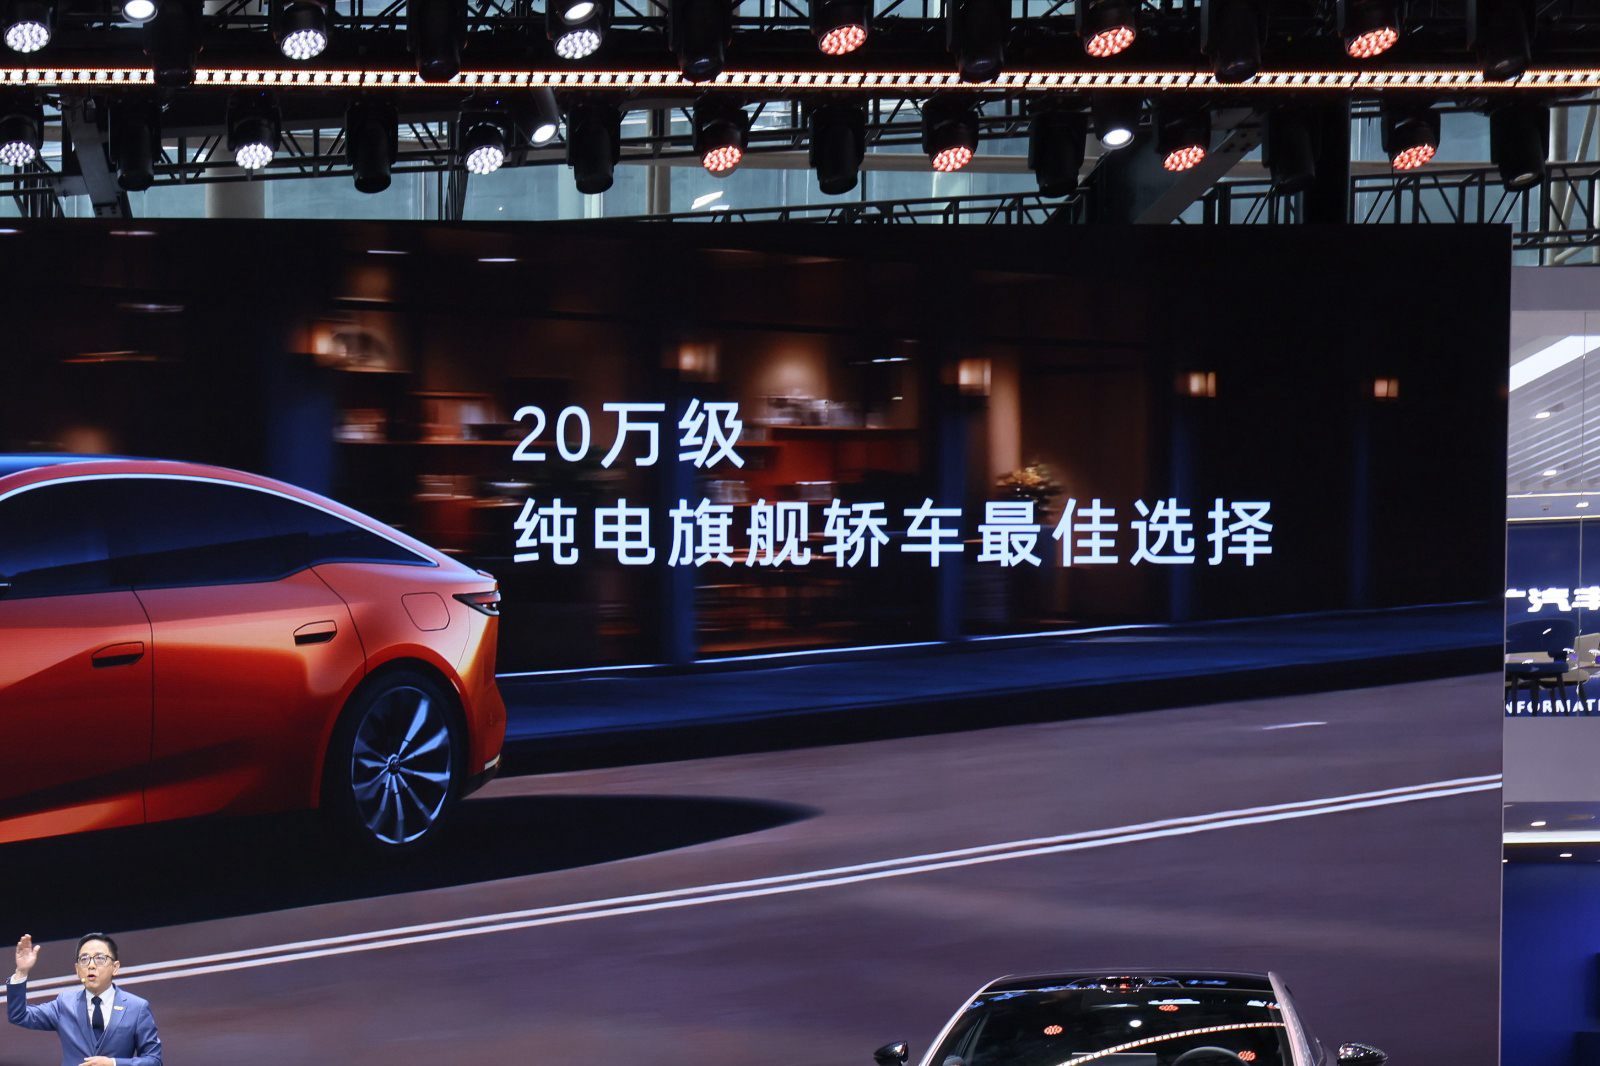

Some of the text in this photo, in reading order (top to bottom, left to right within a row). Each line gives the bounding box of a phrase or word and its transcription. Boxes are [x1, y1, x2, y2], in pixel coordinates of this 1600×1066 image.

[512, 398, 745, 468] 20万级
[513, 497, 1275, 567] 纯电旗舰轿车最佳选择
